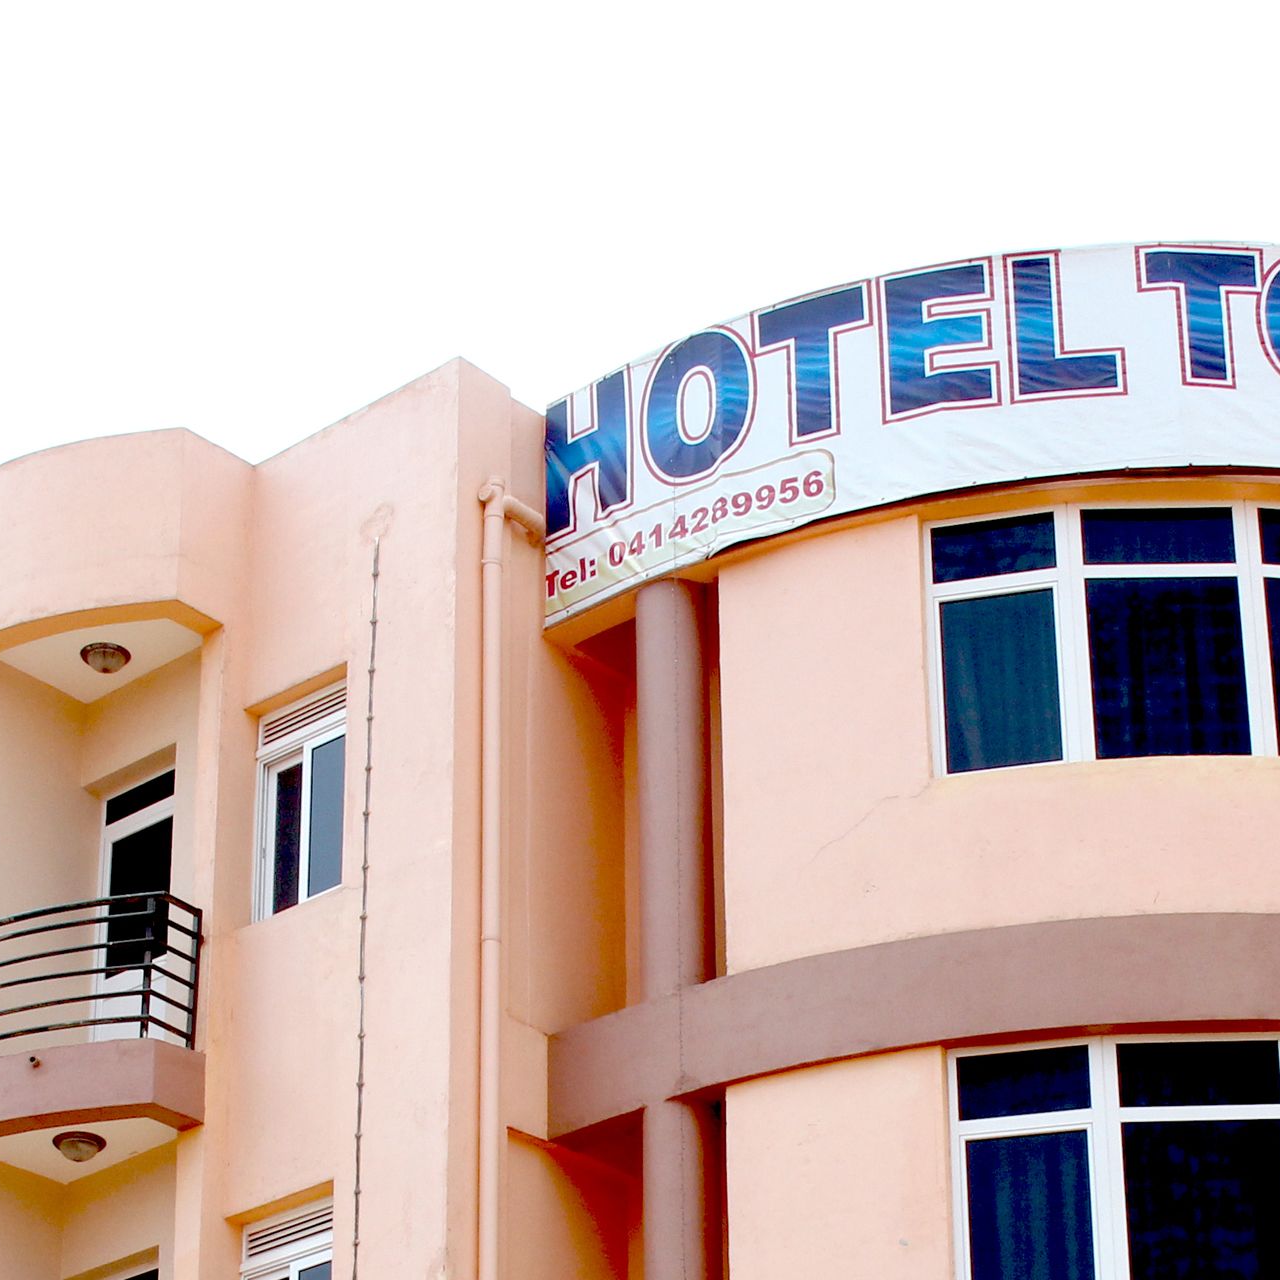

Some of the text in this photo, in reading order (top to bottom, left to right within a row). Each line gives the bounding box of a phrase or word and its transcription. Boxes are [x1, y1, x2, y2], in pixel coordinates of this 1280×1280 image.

[545, 249, 1127, 544] HOTEL
[545, 470, 824, 597] Tel: 0414289956
